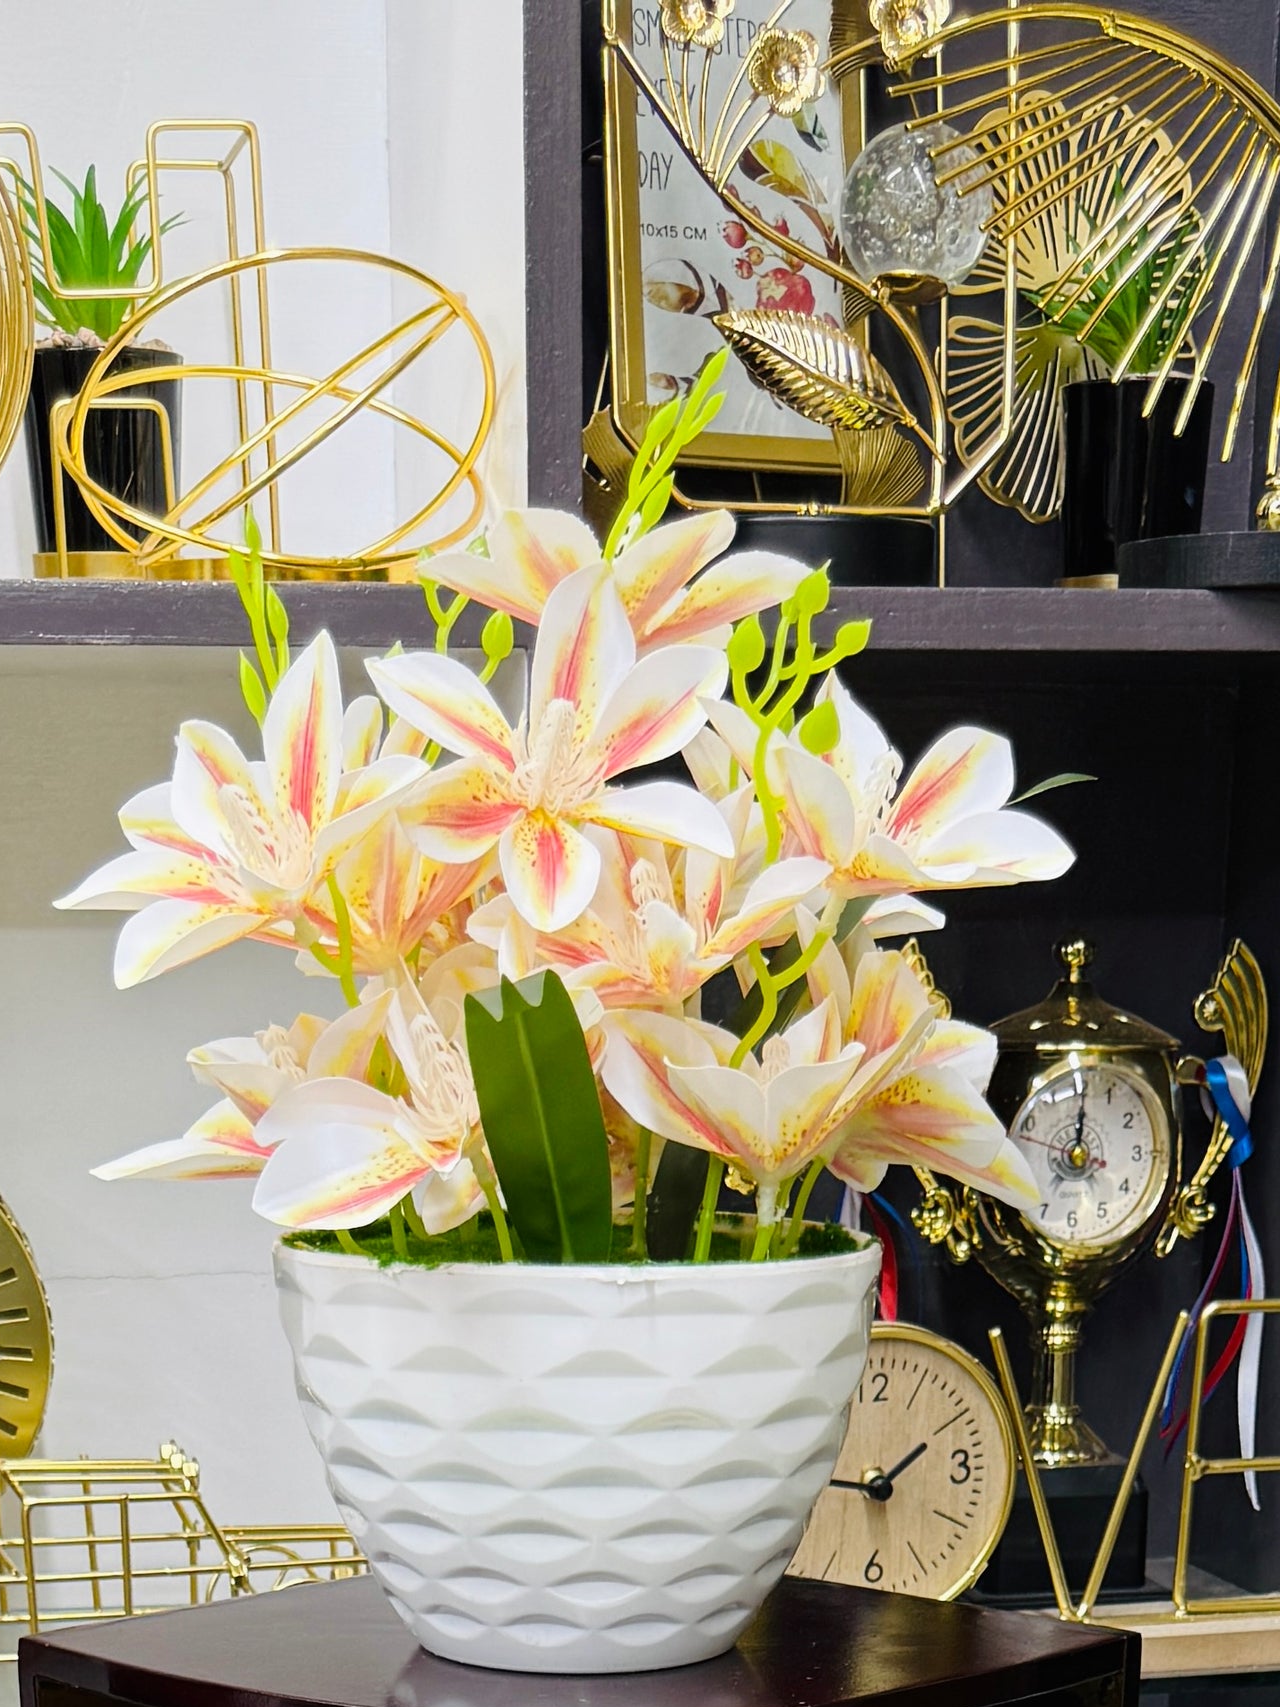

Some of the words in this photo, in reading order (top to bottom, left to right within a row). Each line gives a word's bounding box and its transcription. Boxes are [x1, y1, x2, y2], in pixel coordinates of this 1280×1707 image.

[712, 17, 767, 58] TEP
[638, 150, 673, 190] DAY
[640, 222, 679, 239] 10x15
[682, 225, 708, 241] CM
[1122, 1112, 1134, 1130] 2
[1131, 1145, 1142, 1162] 3
[1118, 1177, 1129, 1195] 4
[1039, 1203, 1050, 1220] 7
[1066, 1210, 1078, 1229] 6
[1096, 1201, 1108, 1219] 5
[858, 1371, 889, 1404] 12
[949, 1448, 971, 1485] 3
[863, 1548, 884, 1584] 6
